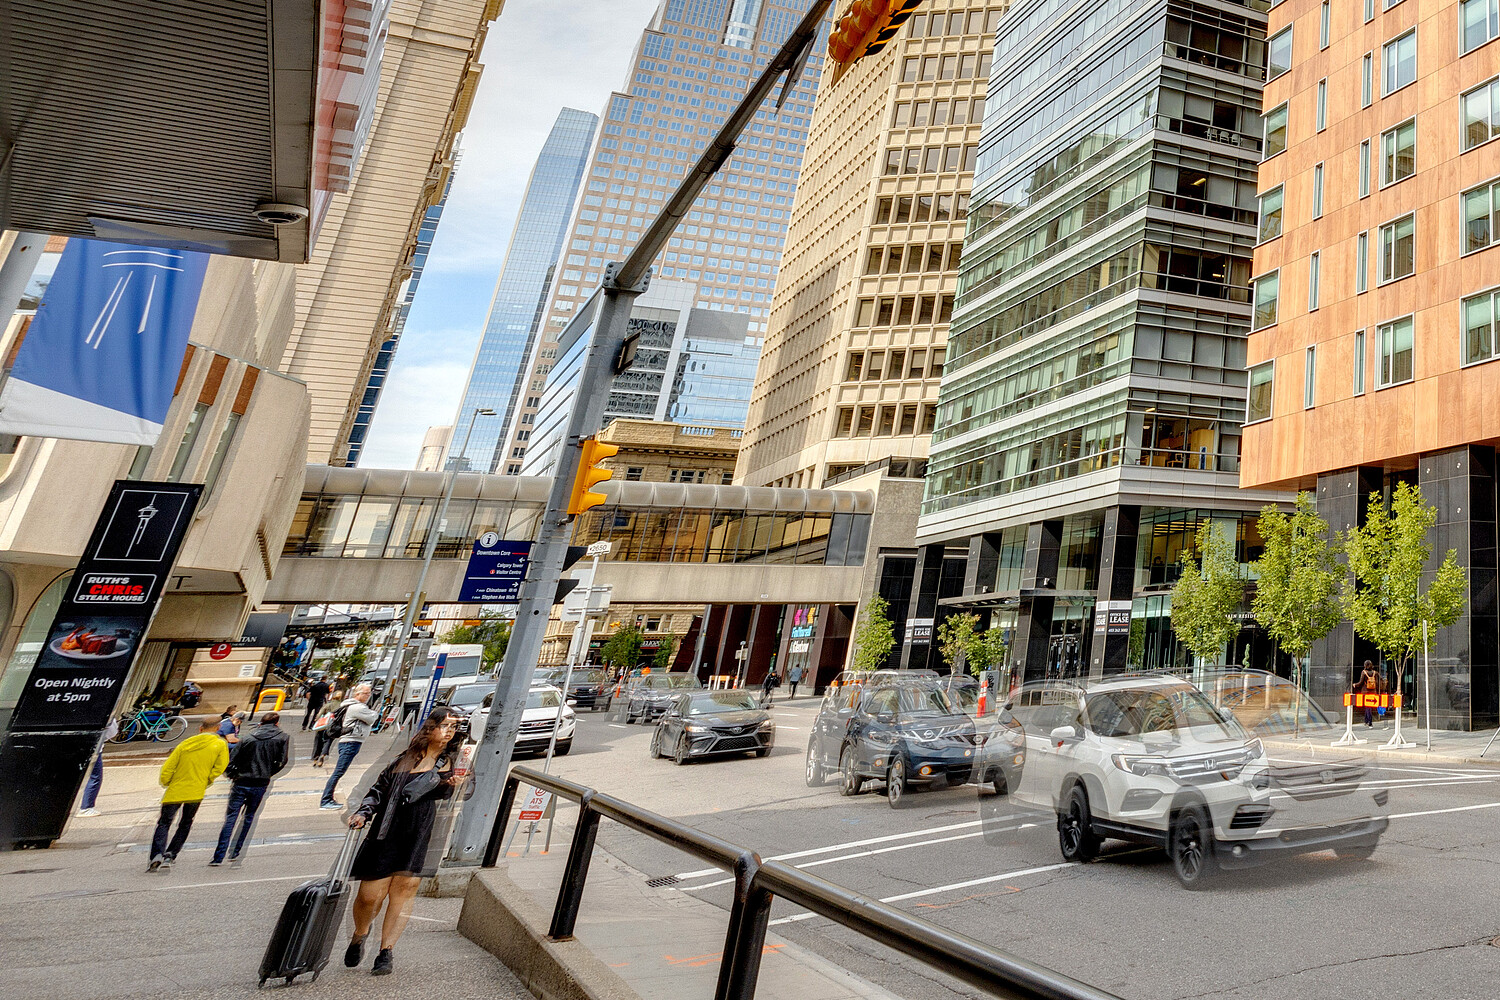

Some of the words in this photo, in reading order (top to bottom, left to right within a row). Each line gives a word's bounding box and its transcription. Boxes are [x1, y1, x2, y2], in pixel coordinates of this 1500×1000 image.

[87, 576, 130, 585] RUTH'S
[78, 594, 111, 602] STEAK
[111, 594, 145, 602] HOUSE
[35, 678, 69, 690] Open
[71, 677, 116, 690] Nightly
[46, 693, 61, 702] at
[63, 692, 91, 704] 5pm
